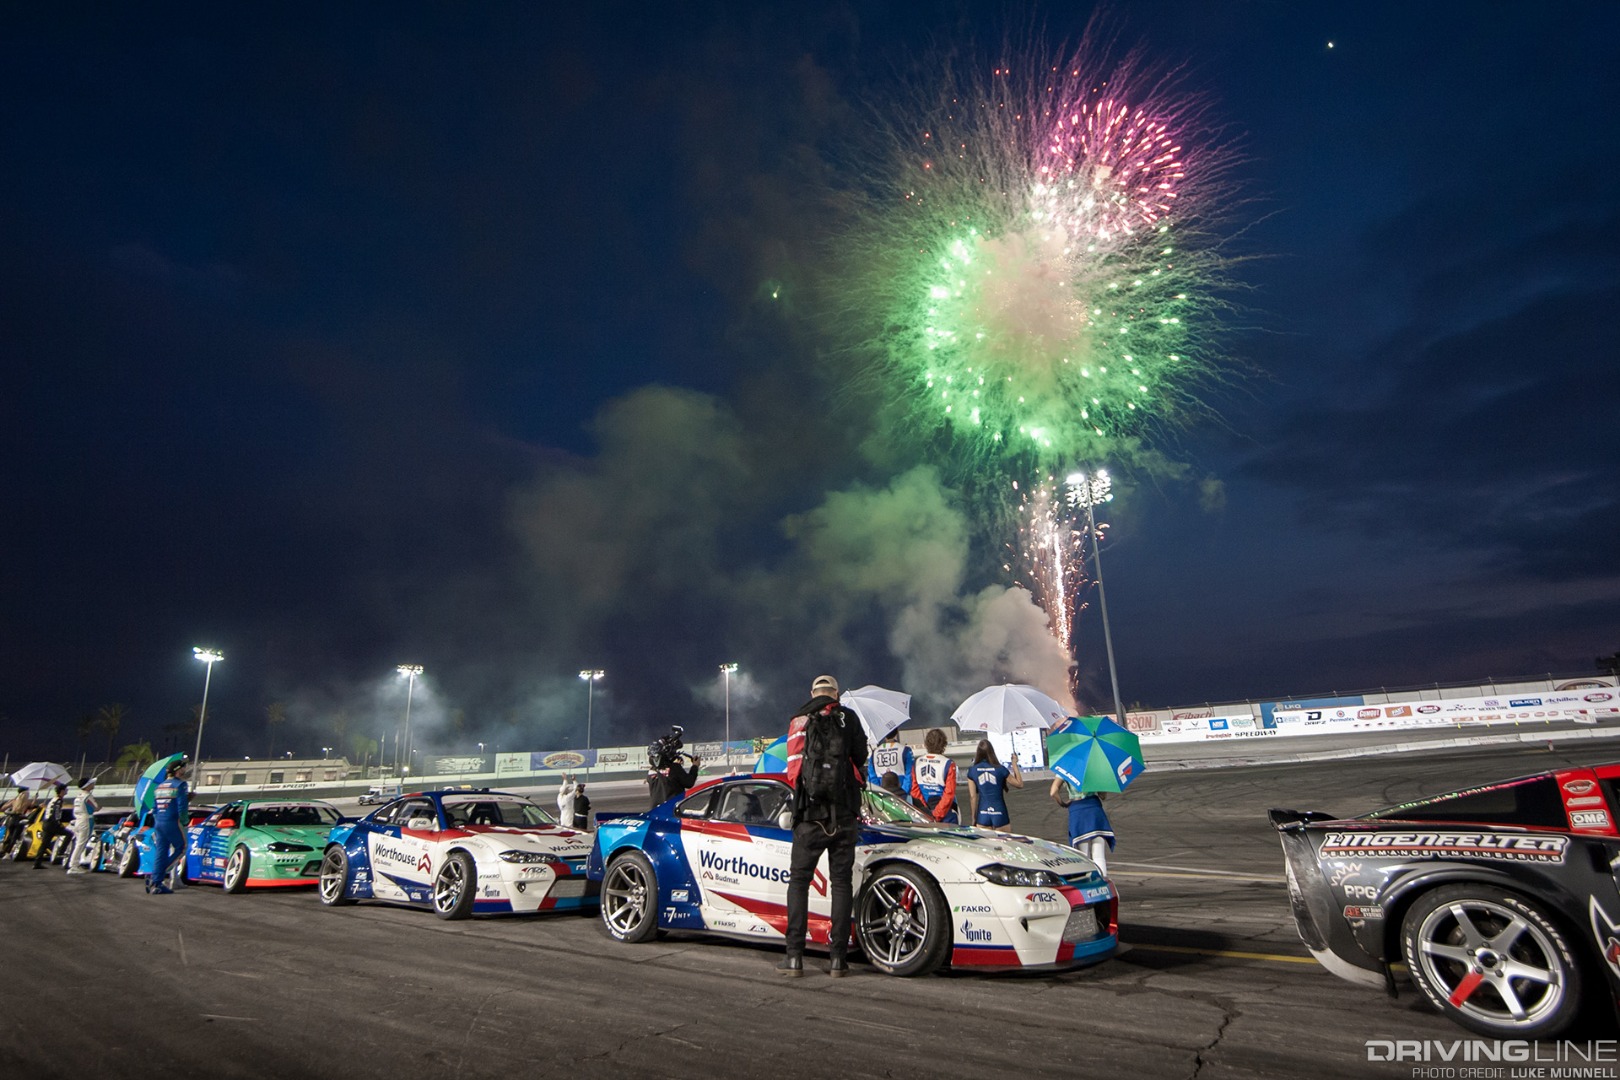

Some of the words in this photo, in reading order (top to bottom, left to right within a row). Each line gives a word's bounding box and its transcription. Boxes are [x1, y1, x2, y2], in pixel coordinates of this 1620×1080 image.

[1234, 729, 1278, 738] SPEEDWAY
[877, 751, 898, 767] 130
[1573, 813, 1605, 823] OMP
[1325, 833, 1565, 851] LINGENFELTER
[1321, 850, 1433, 858] PERFORMANCE
[1440, 850, 1562, 863] ENGINEERING
[700, 849, 791, 884] Worthouse
[1032, 892, 1057, 903] ARK
[1344, 885, 1378, 899] PPG
[961, 905, 992, 913] FAKRO
[718, 920, 736, 928] FAKRO
[966, 929, 992, 941] ignite
